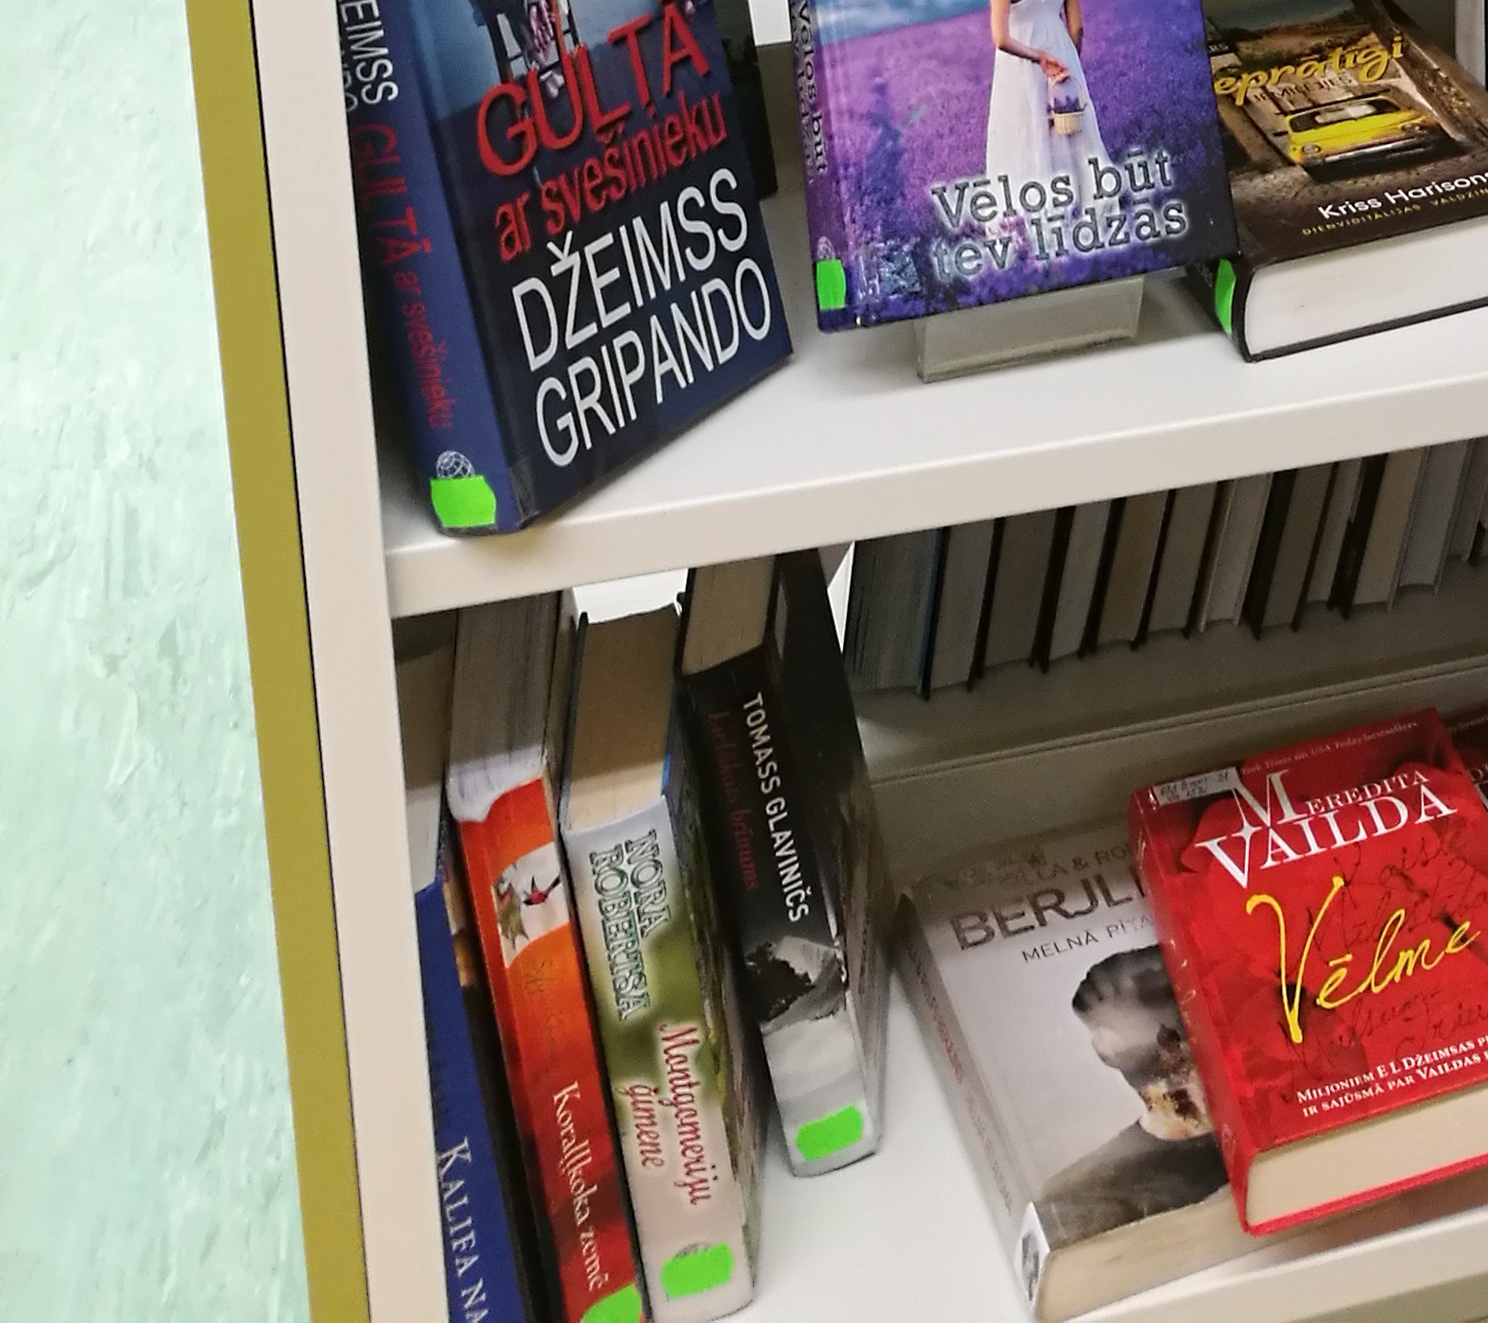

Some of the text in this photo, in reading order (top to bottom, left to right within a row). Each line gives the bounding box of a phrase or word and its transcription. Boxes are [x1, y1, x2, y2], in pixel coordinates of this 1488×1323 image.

[1214, 34, 1405, 107] eprātīgi
[495, 94, 730, 263] ar svešinieku
[930, 148, 1176, 231] Vēlos būt
[1317, 195, 1384, 222] Kriss
[511, 167, 751, 375] DŽEIMSS
[932, 195, 1190, 281] tev līdzās
[535, 258, 773, 469] GRIPANDO
[741, 691, 811, 922] TOMASS GLAVINIČS
[1195, 782, 1459, 889] VAILDA
[1230, 768, 1430, 841] MEREDITA
[588, 850, 652, 1021] ROBERTSA
[625, 828, 671, 938] NORA
[1247, 874, 1480, 1045] Vēlme
[1297, 1072, 1375, 1105] MILJONIEM
[1301, 1104, 1319, 1117] IR
[1386, 1075, 1416, 1091] PAR
[1416, 1052, 1481, 1081] VAILDAS
[436, 1137, 478, 1279] KALIFA
[579, 1227, 609, 1293] zemē
